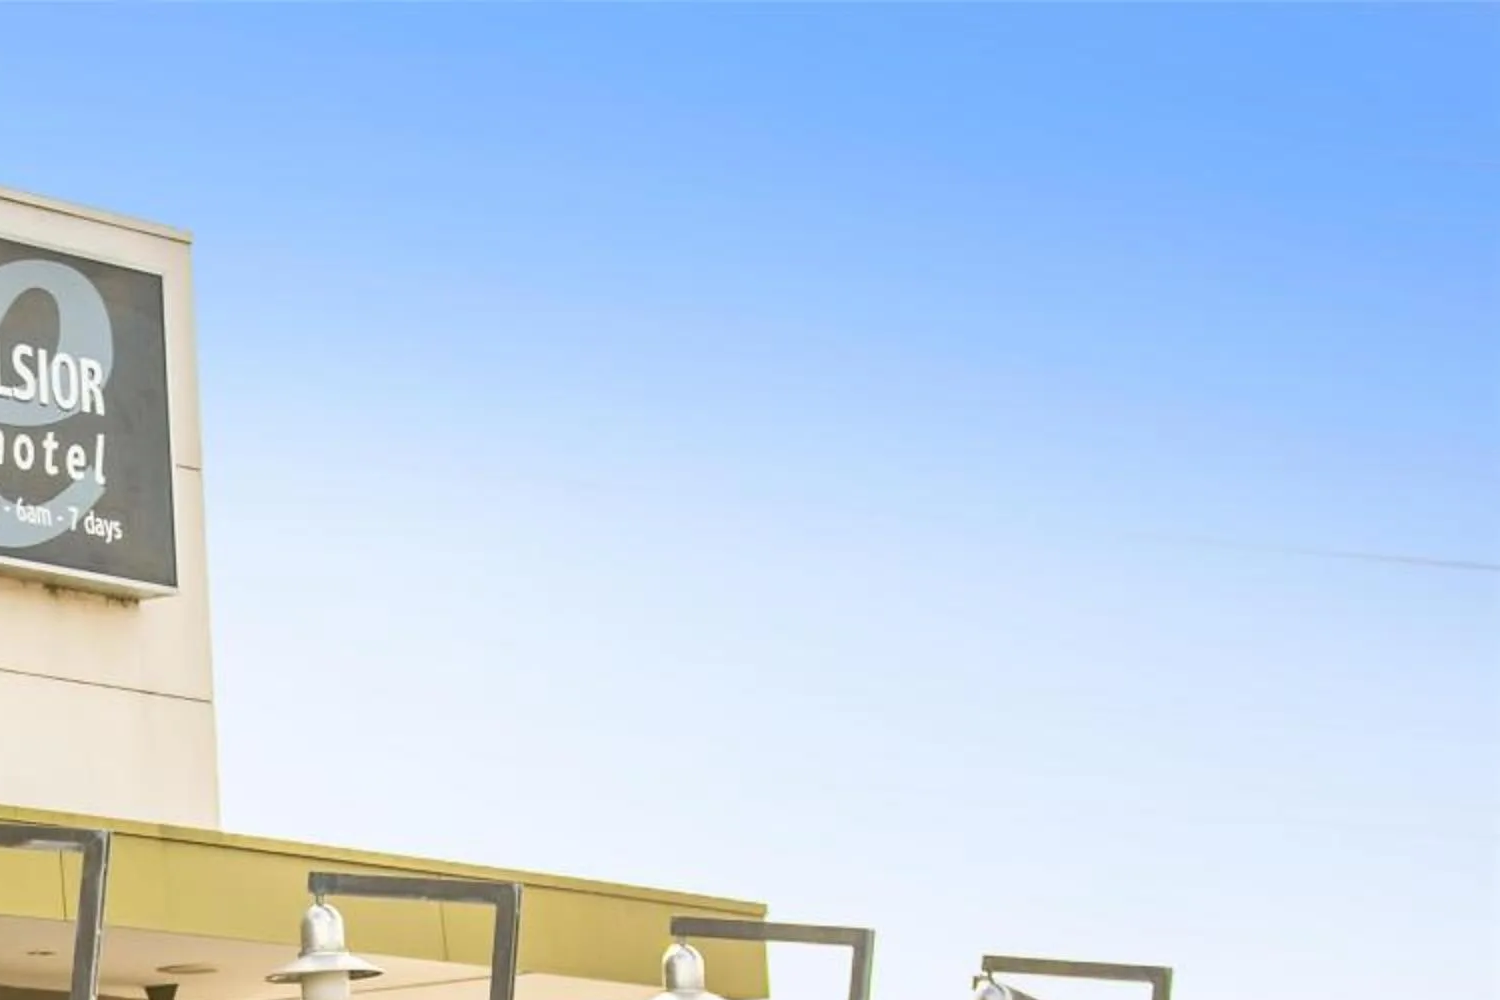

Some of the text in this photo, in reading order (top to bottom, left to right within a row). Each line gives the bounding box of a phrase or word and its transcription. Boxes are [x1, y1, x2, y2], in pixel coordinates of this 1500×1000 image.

[15, 497, 53, 526] 6am
[68, 507, 78, 531] 7
[84, 511, 123, 544] days
